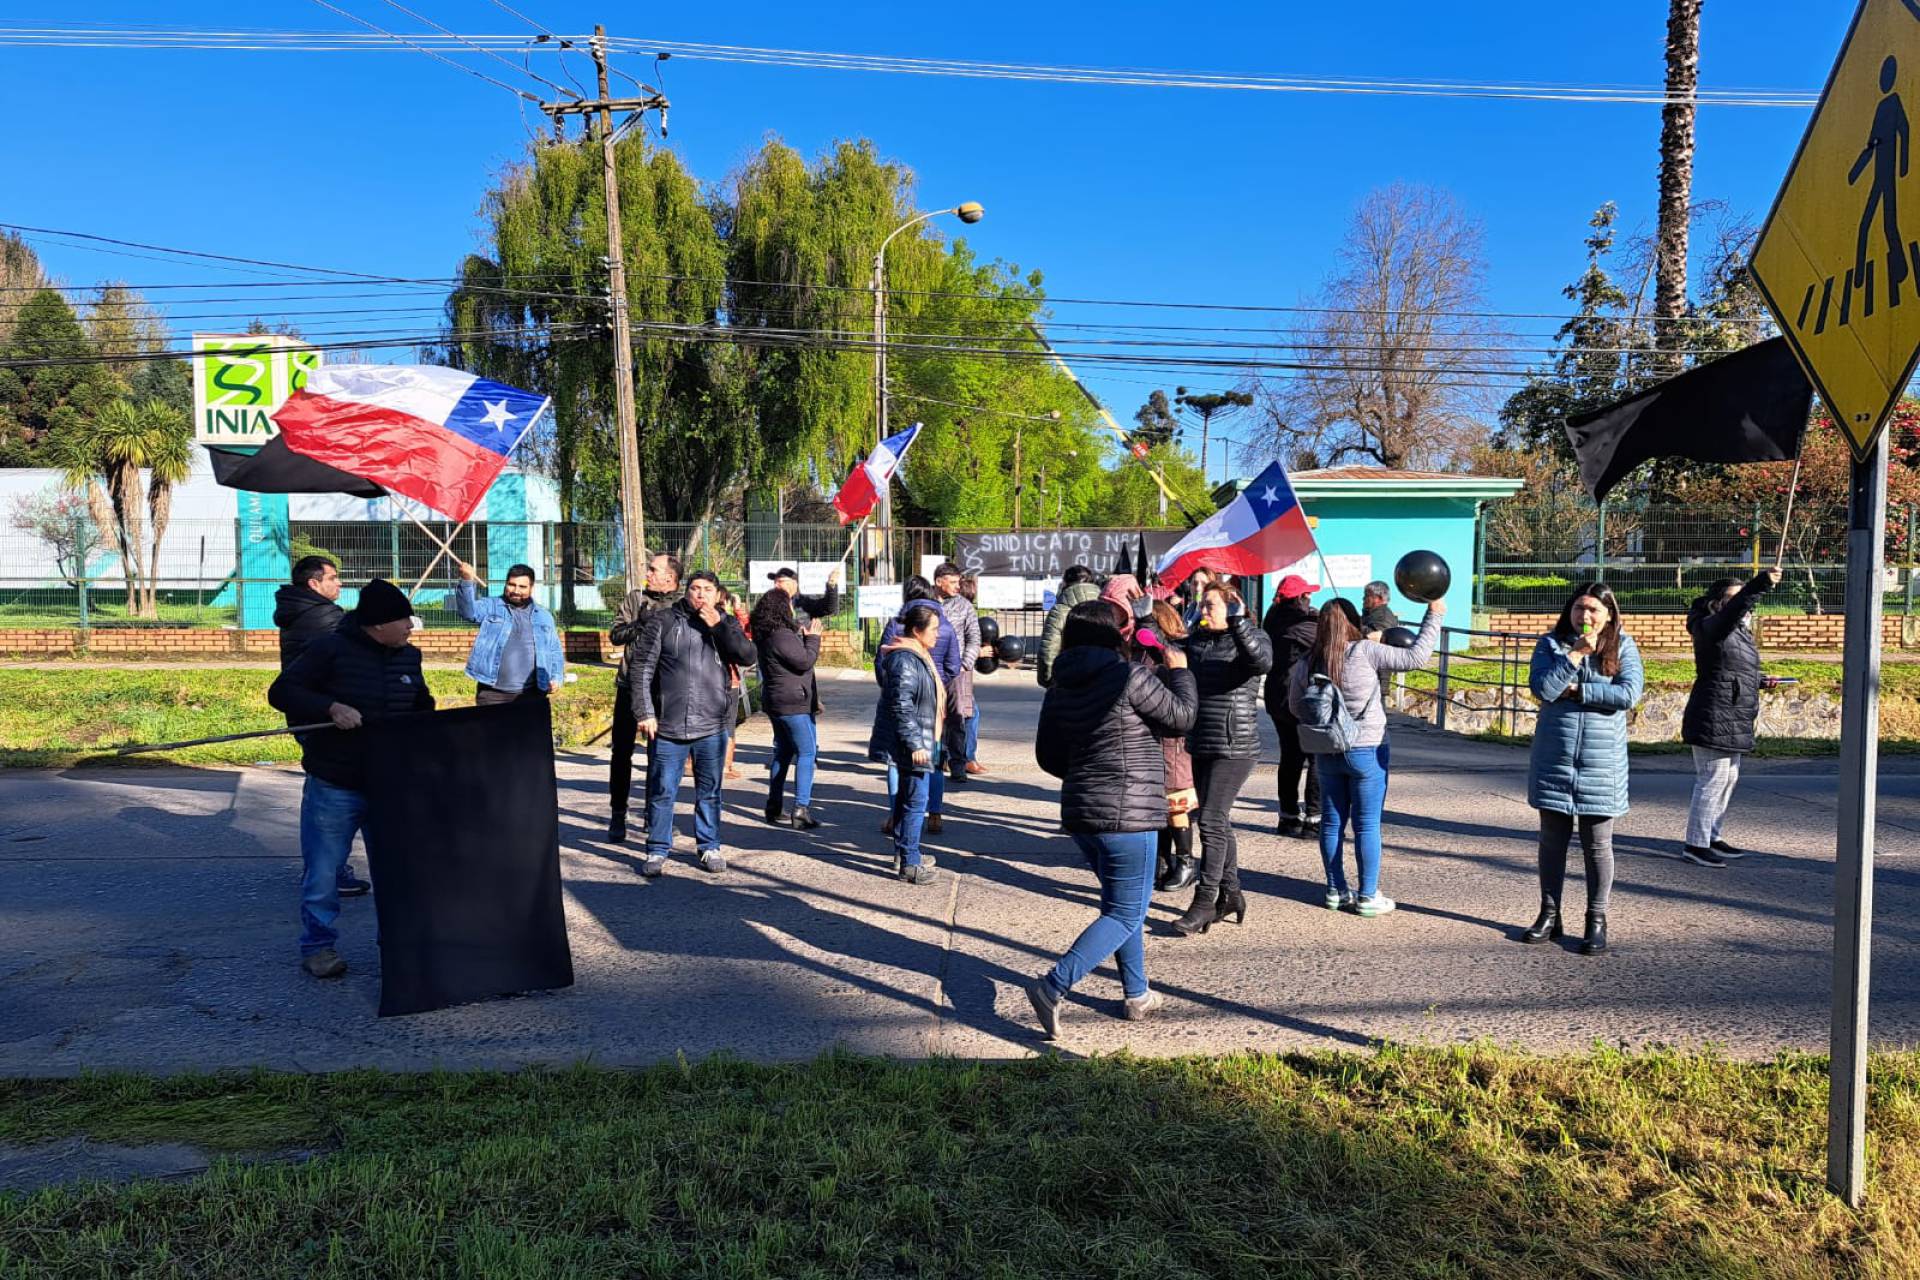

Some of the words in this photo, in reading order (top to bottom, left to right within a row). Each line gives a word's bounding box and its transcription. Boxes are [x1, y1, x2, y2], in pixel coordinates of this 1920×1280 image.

[206, 409, 273, 434] INIA
[980, 533, 1092, 551] SINDICATO
[1008, 554, 1060, 572] INIA
